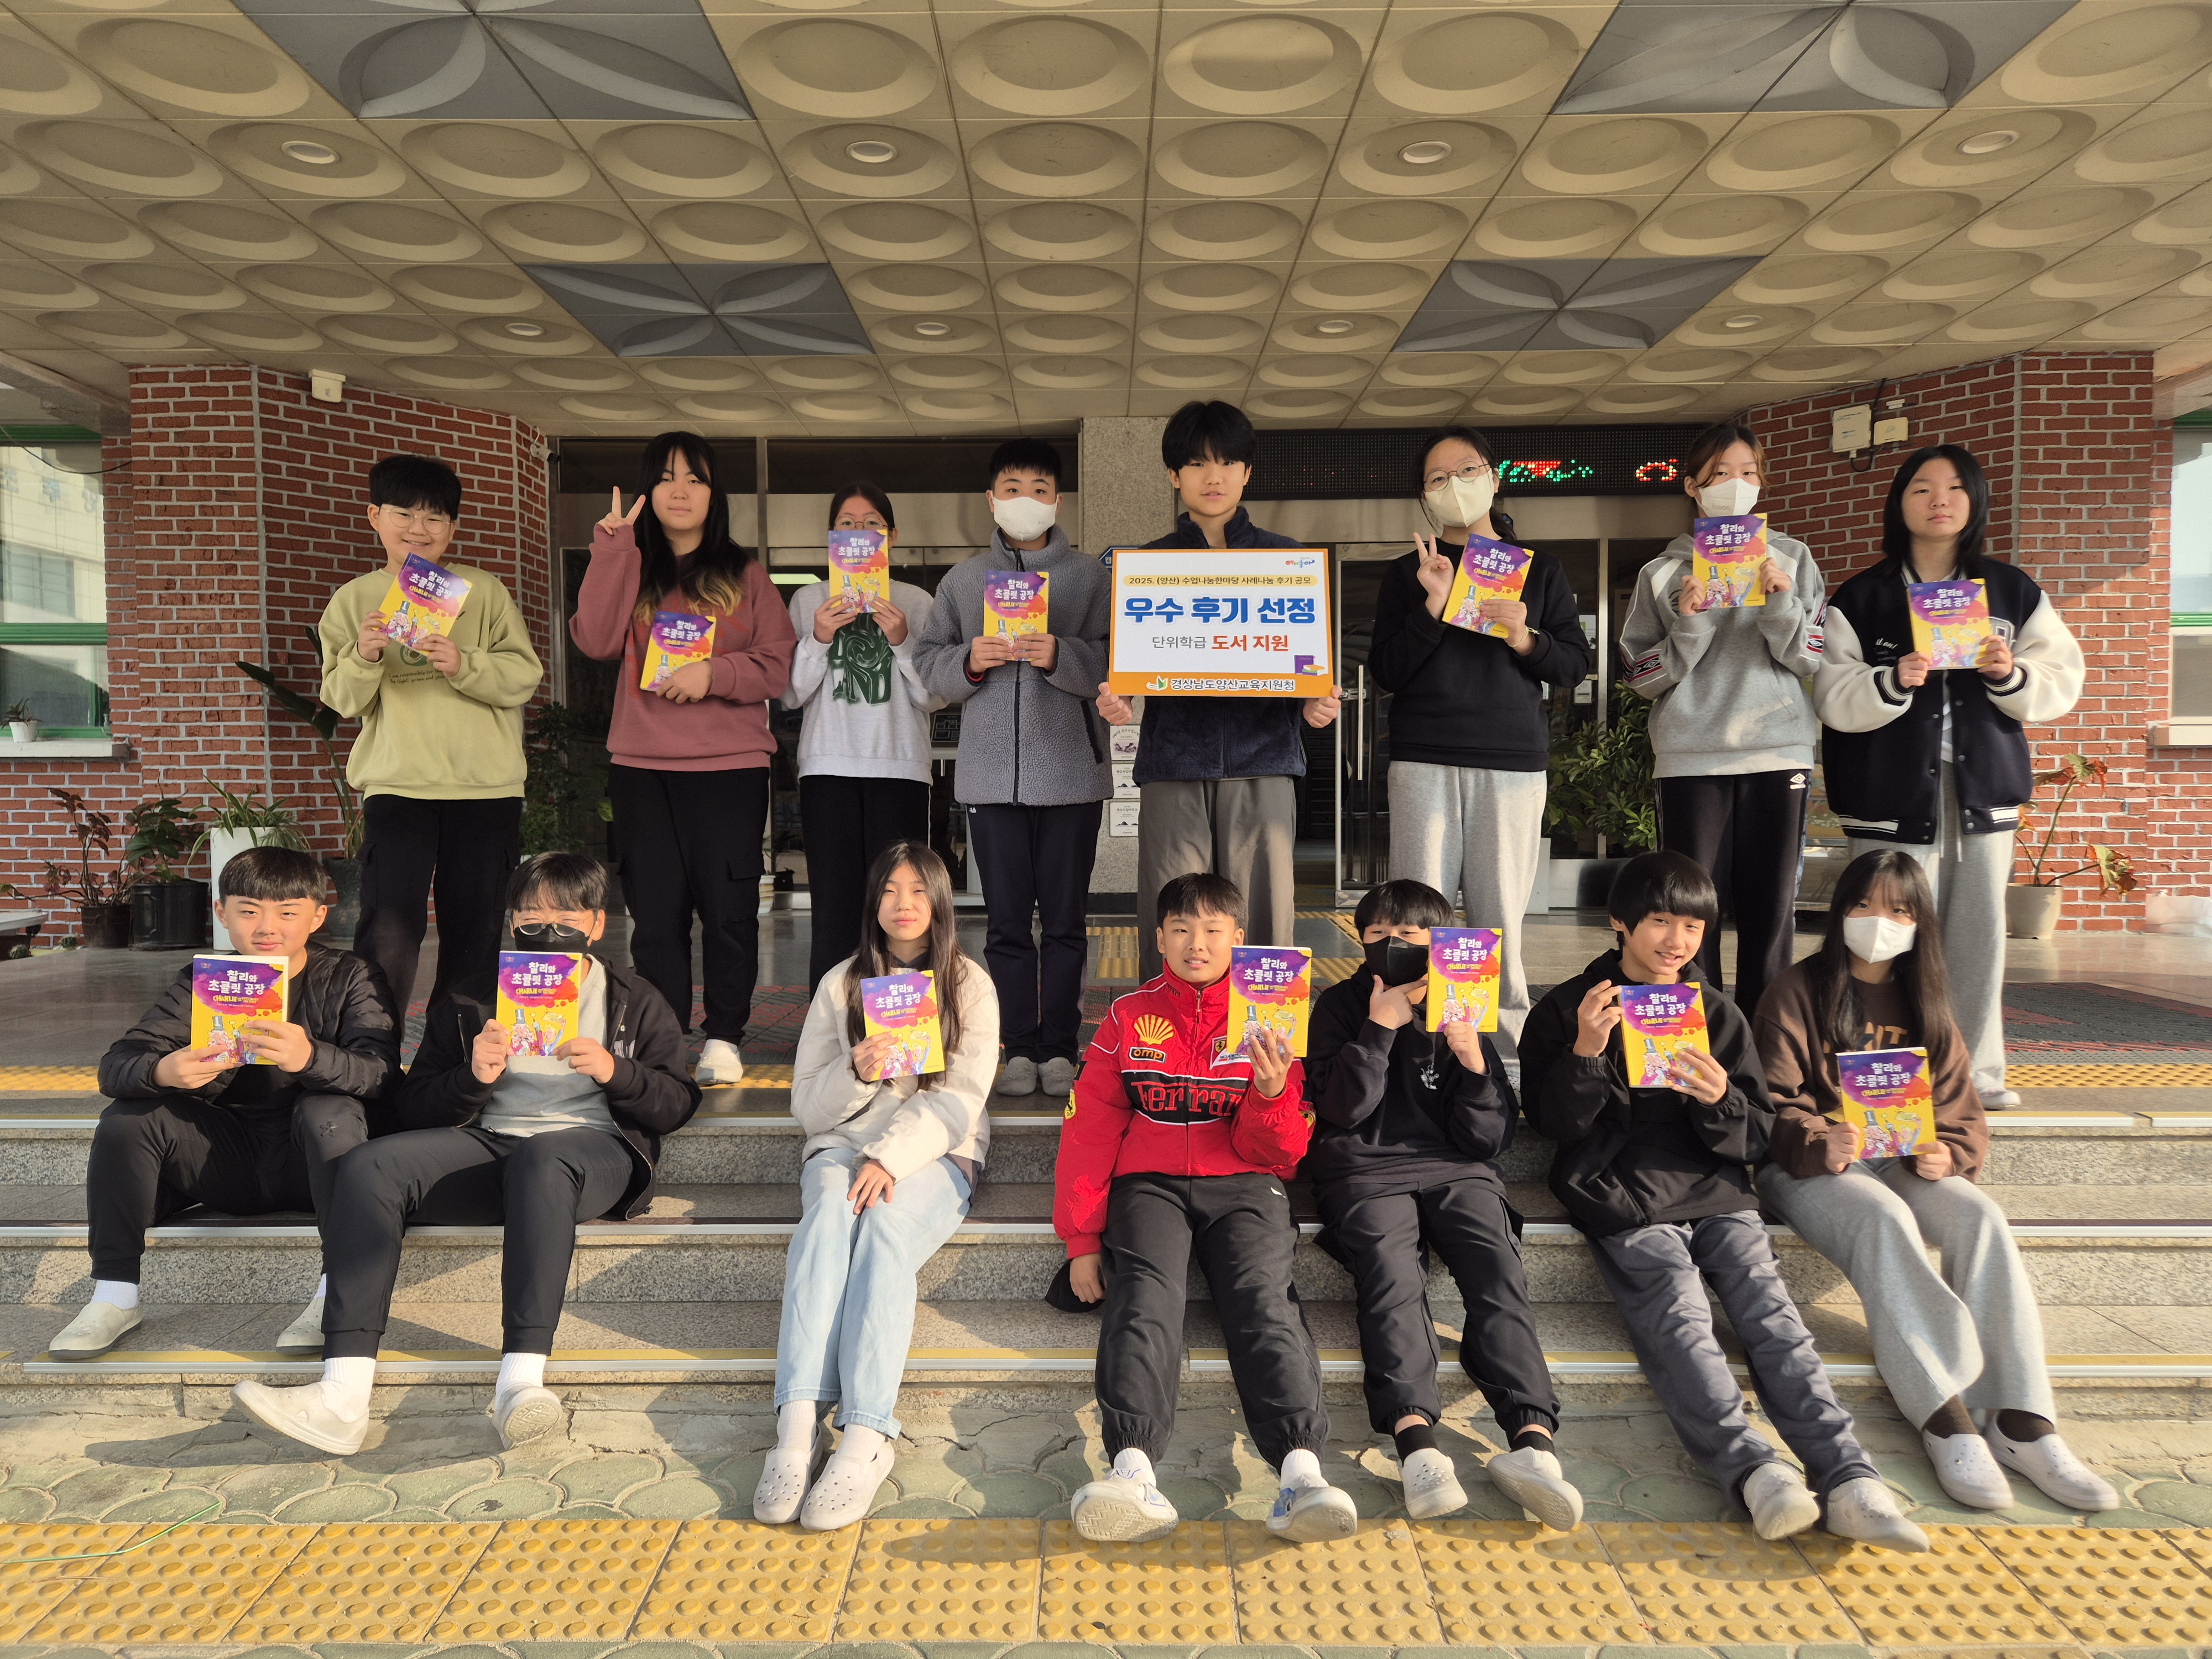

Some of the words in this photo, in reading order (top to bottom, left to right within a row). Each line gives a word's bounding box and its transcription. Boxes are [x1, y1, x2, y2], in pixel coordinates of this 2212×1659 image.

[1720, 524, 1745, 534] 찰리와
[849, 538, 870, 547] 찰리와
[1705, 535, 1731, 546] 초콜릿
[1734, 533, 1751, 544] 공장
[838, 546, 860, 557] 초콜릿
[862, 546, 875, 556] 공장
[1490, 548, 1511, 563] 찰리와
[1473, 554, 1498, 570] 초콜릿
[1499, 562, 1515, 574] 공장
[428, 570, 450, 588] 찰리와
[1474, 568, 1492, 577] CHARLIE
[409, 573, 435, 592] 초콜릿
[436, 586, 452, 599] 공장
[1008, 579, 1029, 589] 찰리와
[1157, 577, 1180, 585] (양산)
[994, 588, 1018, 600] 초콜릿
[1020, 589, 1034, 600] 공장
[1937, 588, 1963, 598] 찰리와
[1923, 598, 1952, 609] 초콜릿
[1953, 596, 1971, 607] 공장
[1124, 597, 1185, 623] 우수
[1191, 596, 1249, 623] 후기
[1257, 597, 1316, 624] 선정
[676, 620, 697, 630] 찰리와
[661, 627, 685, 639] 초콜릿
[686, 631, 701, 640] 공장
[1152, 635, 1207, 649] 단위학급
[1211, 635, 1247, 651] 도서
[1253, 634, 1289, 652] 지원
[1171, 678, 1295, 691] 경상남도양산교육지원청
[1458, 937, 1482, 949] 찰리와
[1442, 948, 1469, 962] 초콜릿
[1471, 950, 1488, 962] 공장
[529, 962, 556, 974] 찰리와
[1260, 957, 1287, 969] 찰리와
[227, 969, 258, 983] 찰리와
[512, 973, 541, 987] 초콜릿
[544, 973, 563, 986] 공장
[1243, 968, 1272, 982] 초콜릿
[1275, 971, 1294, 983] 공장
[207, 979, 241, 994] 초콜릿
[244, 983, 265, 995] 공장
[889, 984, 914, 995] 찰리와
[875, 995, 902, 1009] 초콜릿
[905, 992, 921, 1005] 공장
[1649, 993, 1678, 1004] 찰리와
[881, 1009, 901, 1018] CHARLIE
[1635, 1004, 1665, 1016] 초콜릿
[1667, 1003, 1686, 1015] 공장
[1134, 1048, 1164, 1060] omp
[1870, 1062, 1902, 1074] 찰리와
[1854, 1075, 1888, 1088] 초콜릿
[1890, 1072, 1911, 1086] 공장
[1131, 1081, 1246, 1117] Ferrar
